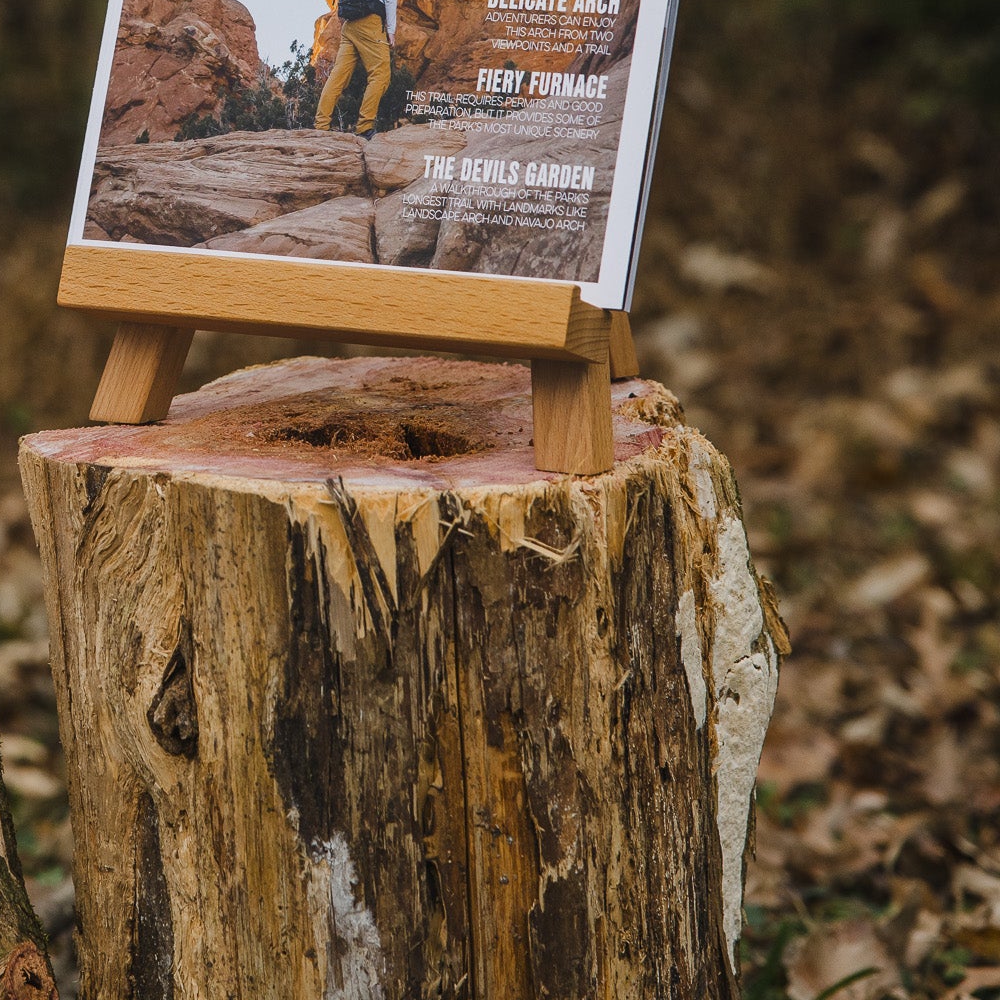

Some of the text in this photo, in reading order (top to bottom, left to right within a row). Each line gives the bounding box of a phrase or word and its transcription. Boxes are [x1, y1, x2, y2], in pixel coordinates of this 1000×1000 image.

[485, 12, 617, 28] ADVENTURERS CAN ENJOY
[505, 26, 613, 41] THIS ARCH FROM TWO
[491, 39, 611, 55] VIEWPOINTS AND A TRAIL
[476, 69, 608, 99] FIERY FURNACE
[405, 90, 603, 112] THIS TRAIL REQUIRES PERMITS AND GOOD
[475, 109, 493, 118] BUT
[496, 109, 504, 119] IT
[506, 111, 553, 123] PROVIDES
[555, 113, 584, 124] SOME
[586, 115, 601, 125] OF
[428, 119, 447, 129] THE
[484, 123, 512, 133] MOST
[513, 125, 551, 137] UNIQUE
[553, 128, 600, 139] SCENERY
[424, 155, 595, 190] THE DEVILS GARDEN
[430, 184, 438, 192] A
[438, 184, 515, 198] WALKTHROUGH
[518, 189, 532, 199] OF
[533, 191, 553, 201] THE
[402, 194, 587, 218] LONGEST TRAIL WITH LANDMARKS LIKE
[402, 208, 585, 231] LANDSCAPE ARCH AND NAVAJO ARCH
